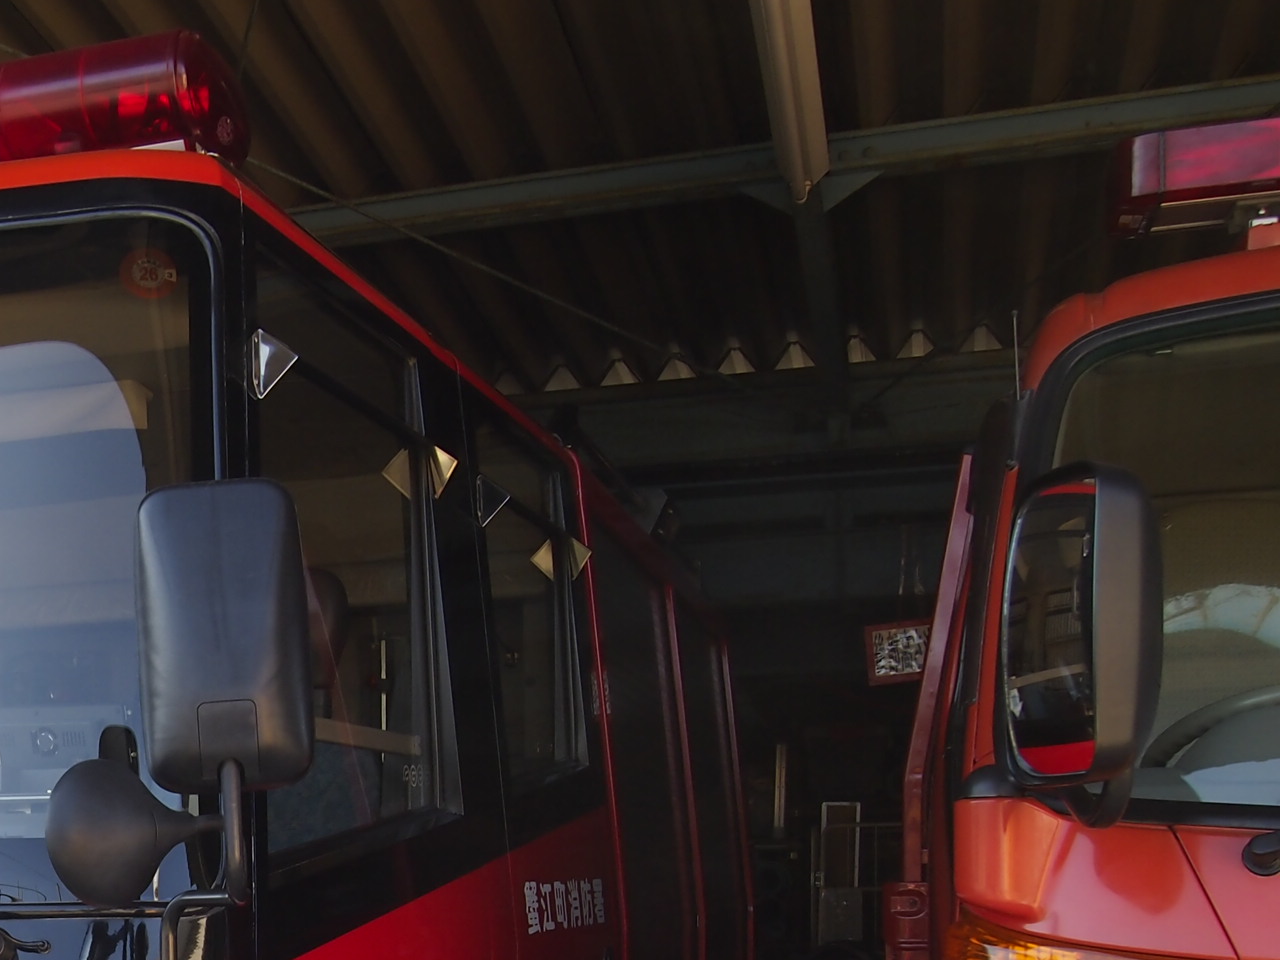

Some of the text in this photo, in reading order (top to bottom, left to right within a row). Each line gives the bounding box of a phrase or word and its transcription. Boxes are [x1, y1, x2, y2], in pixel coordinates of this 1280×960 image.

[524, 878, 605, 934] 蟹江町消防署
